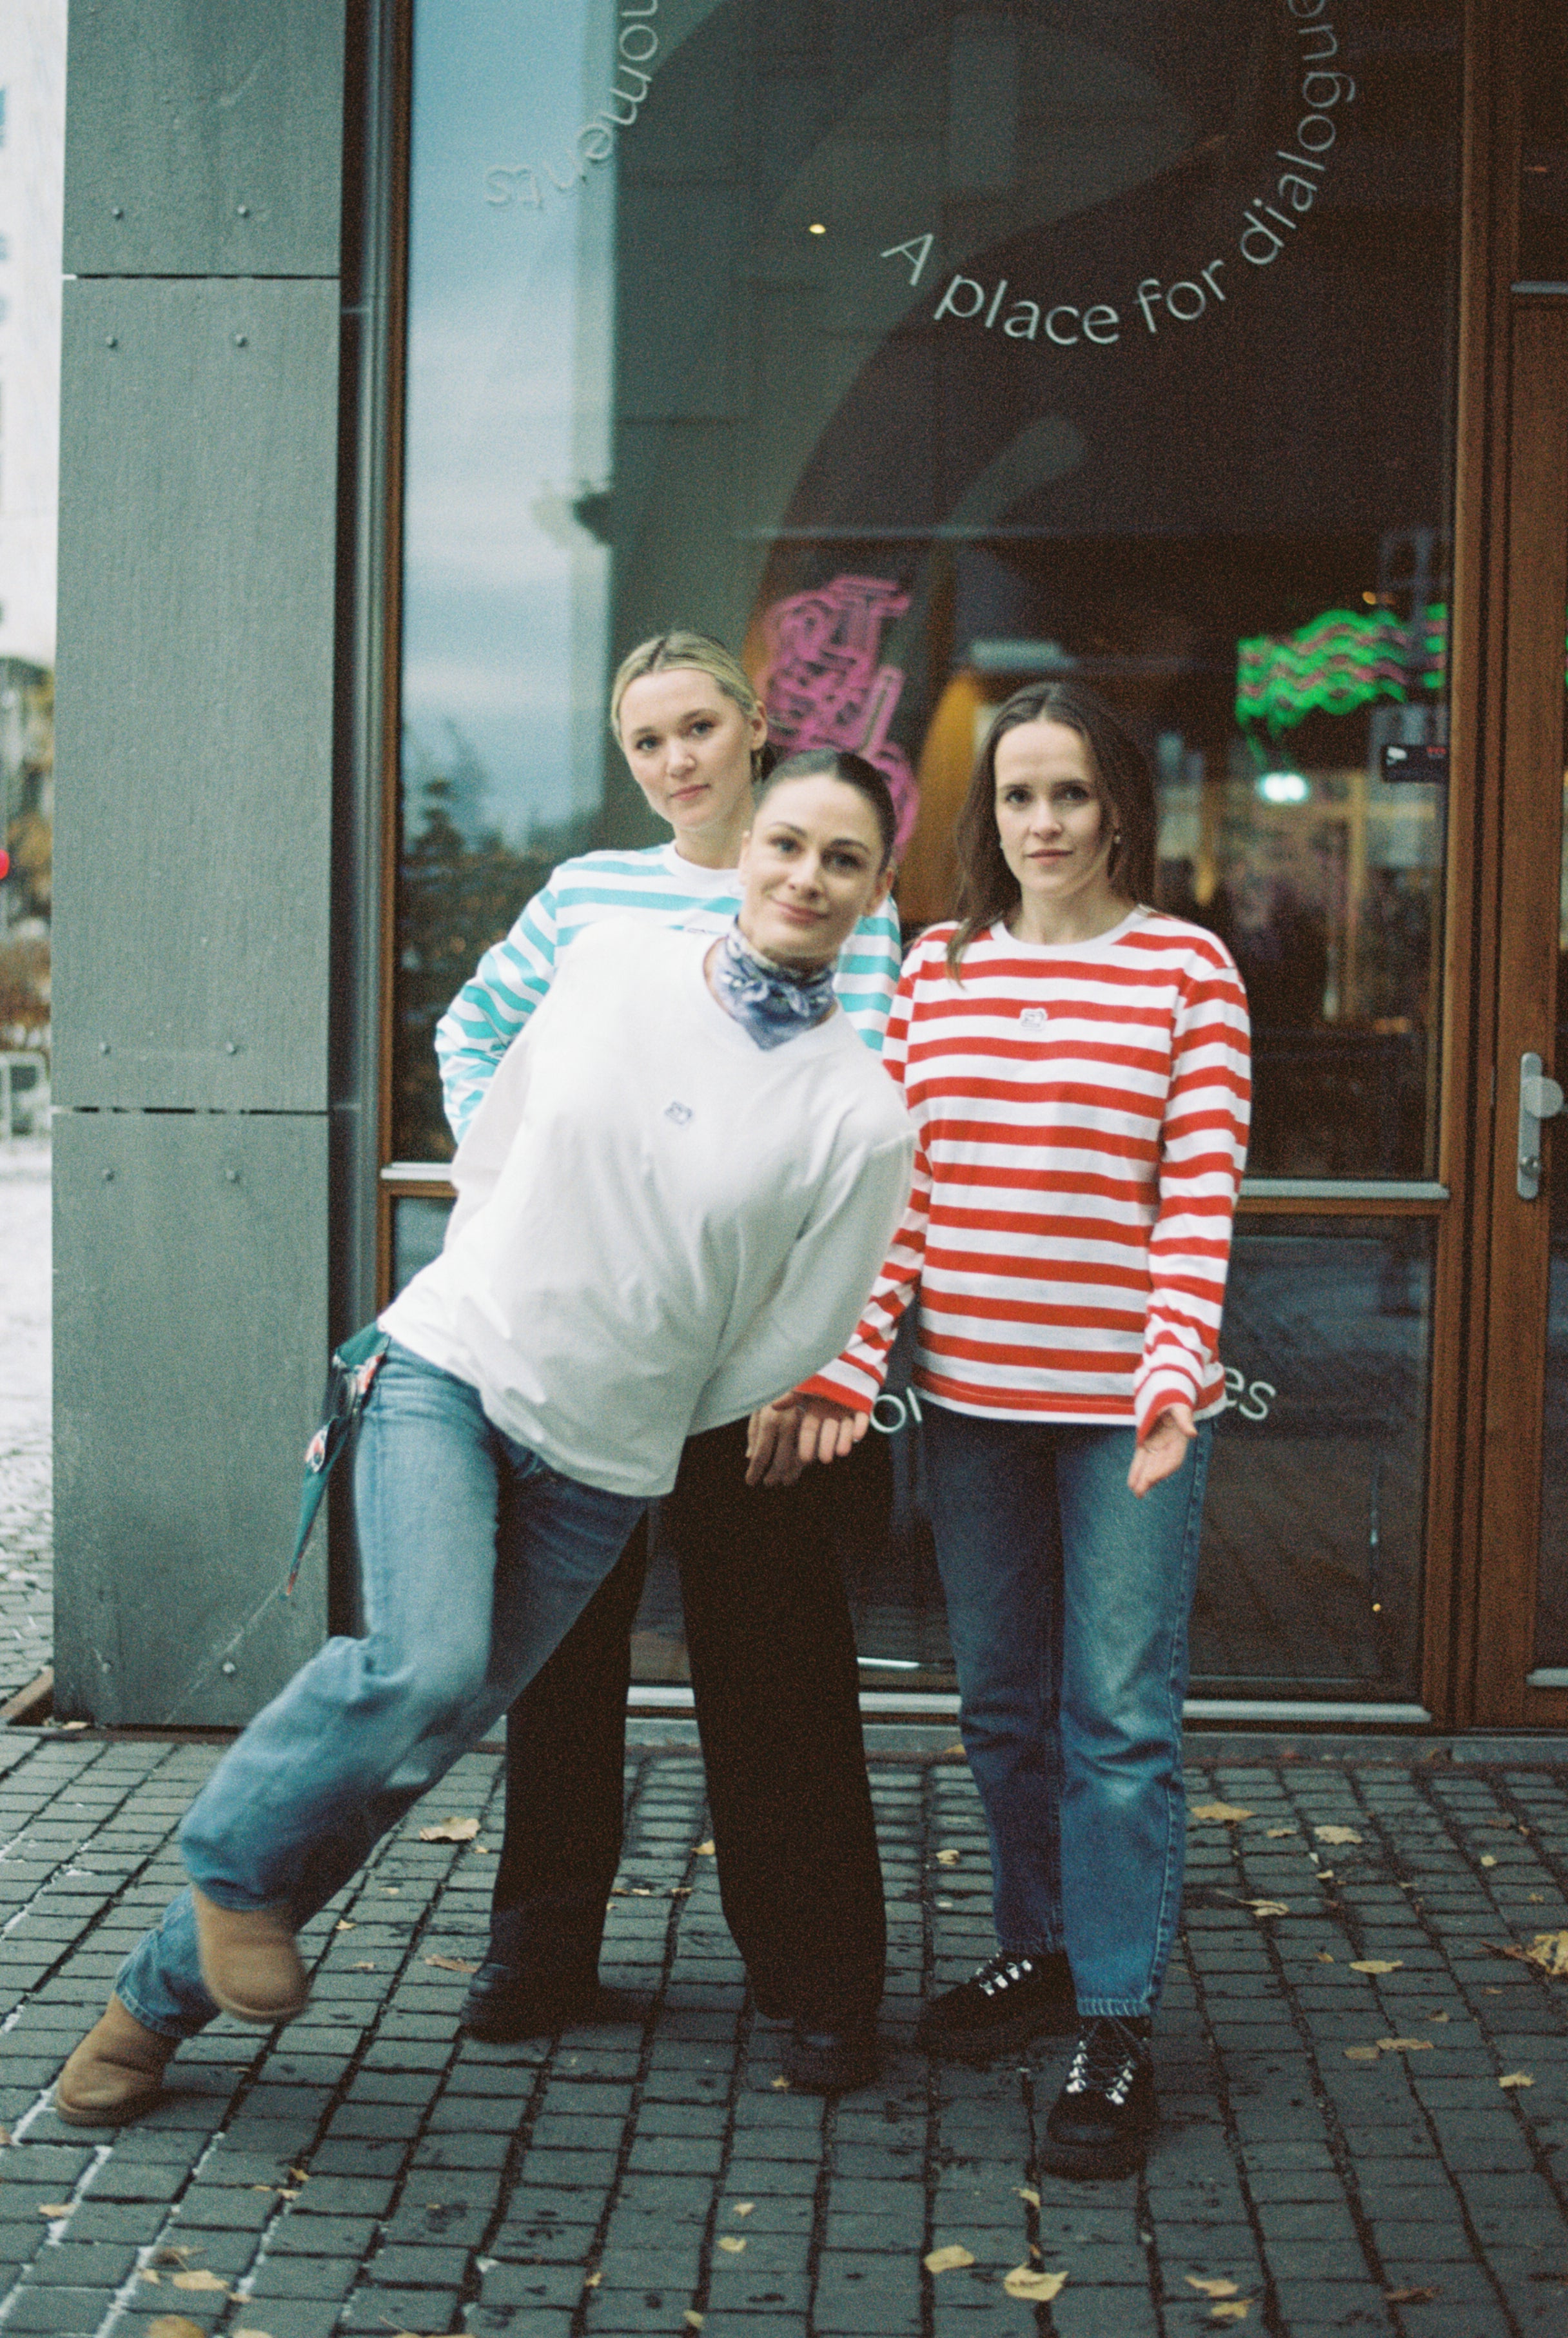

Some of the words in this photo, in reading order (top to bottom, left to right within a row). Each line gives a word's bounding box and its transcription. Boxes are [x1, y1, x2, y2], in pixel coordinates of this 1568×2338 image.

[880, 233, 934, 286] A
[934, 274, 1120, 346] place
[1132, 259, 1226, 333] for
[1240, 0, 1355, 265] dialogue
